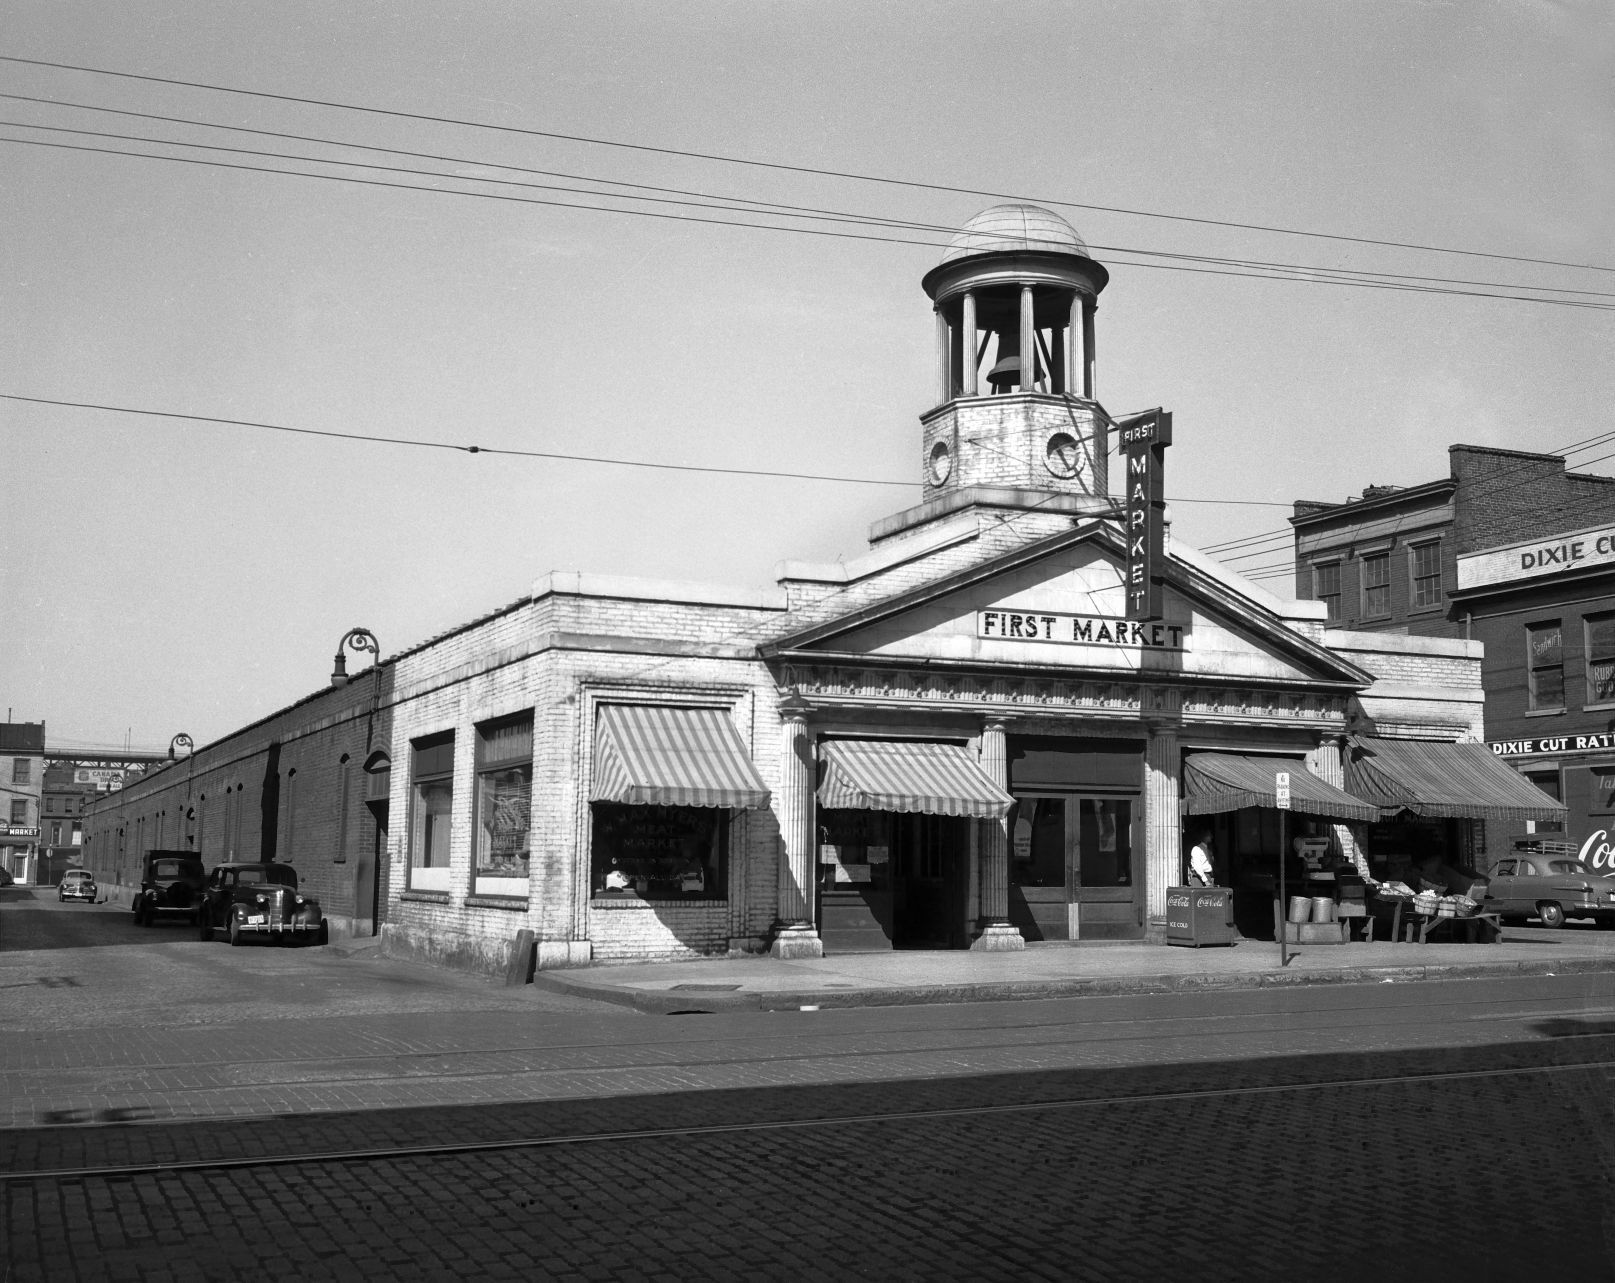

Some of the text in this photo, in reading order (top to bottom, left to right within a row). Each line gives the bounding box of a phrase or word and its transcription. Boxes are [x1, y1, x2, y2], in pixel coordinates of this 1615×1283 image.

[1123, 422, 1156, 442] FIRST
[1130, 453, 1146, 611] MARKET
[1521, 541, 1585, 570] DIXIE
[984, 612, 1184, 648] FIRST MARKET
[1492, 741, 1533, 755] DIXIE
[1540, 738, 1568, 751] CUT
[10, 828, 38, 836] MARKET
